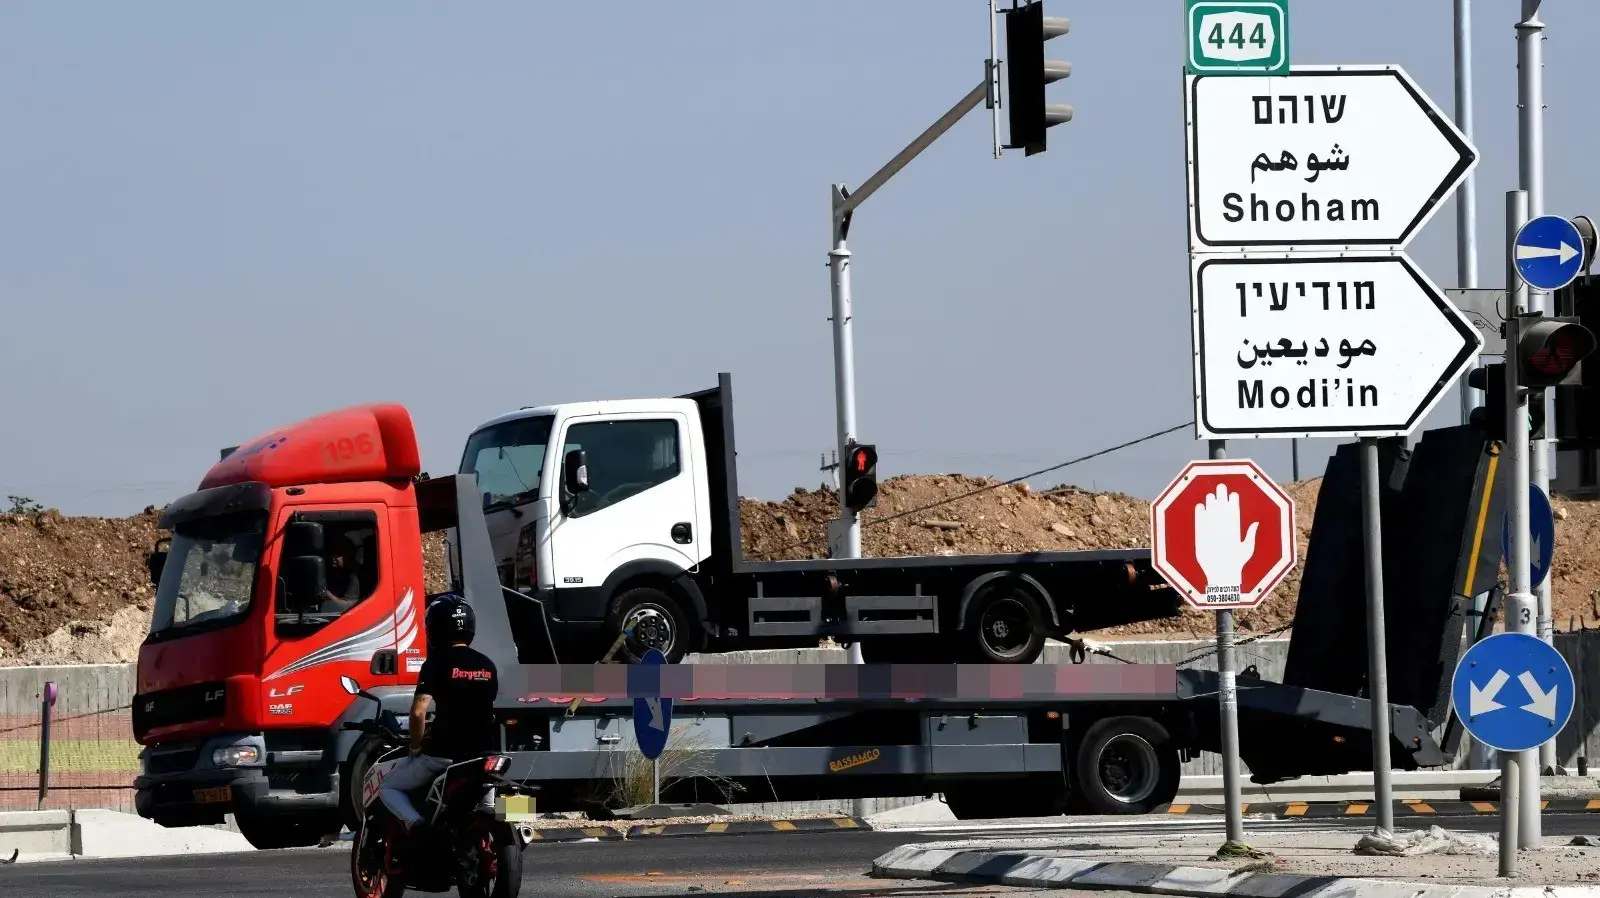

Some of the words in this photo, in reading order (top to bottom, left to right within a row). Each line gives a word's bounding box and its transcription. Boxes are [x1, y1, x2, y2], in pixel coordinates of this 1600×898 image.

[1208, 22, 1267, 50] 444
[1252, 94, 1347, 124] שוהם
[1251, 143, 1350, 184] شوهم
[1222, 192, 1380, 222] Shoham
[1236, 281, 1375, 317] מודיעין
[1237, 337, 1377, 369] موديعين
[326, 433, 374, 462] 196
[1521, 608, 1531, 624] 3
[452, 667, 491, 680] Burgerim
[205, 690, 224, 701] LF
[269, 685, 304, 697] LF
